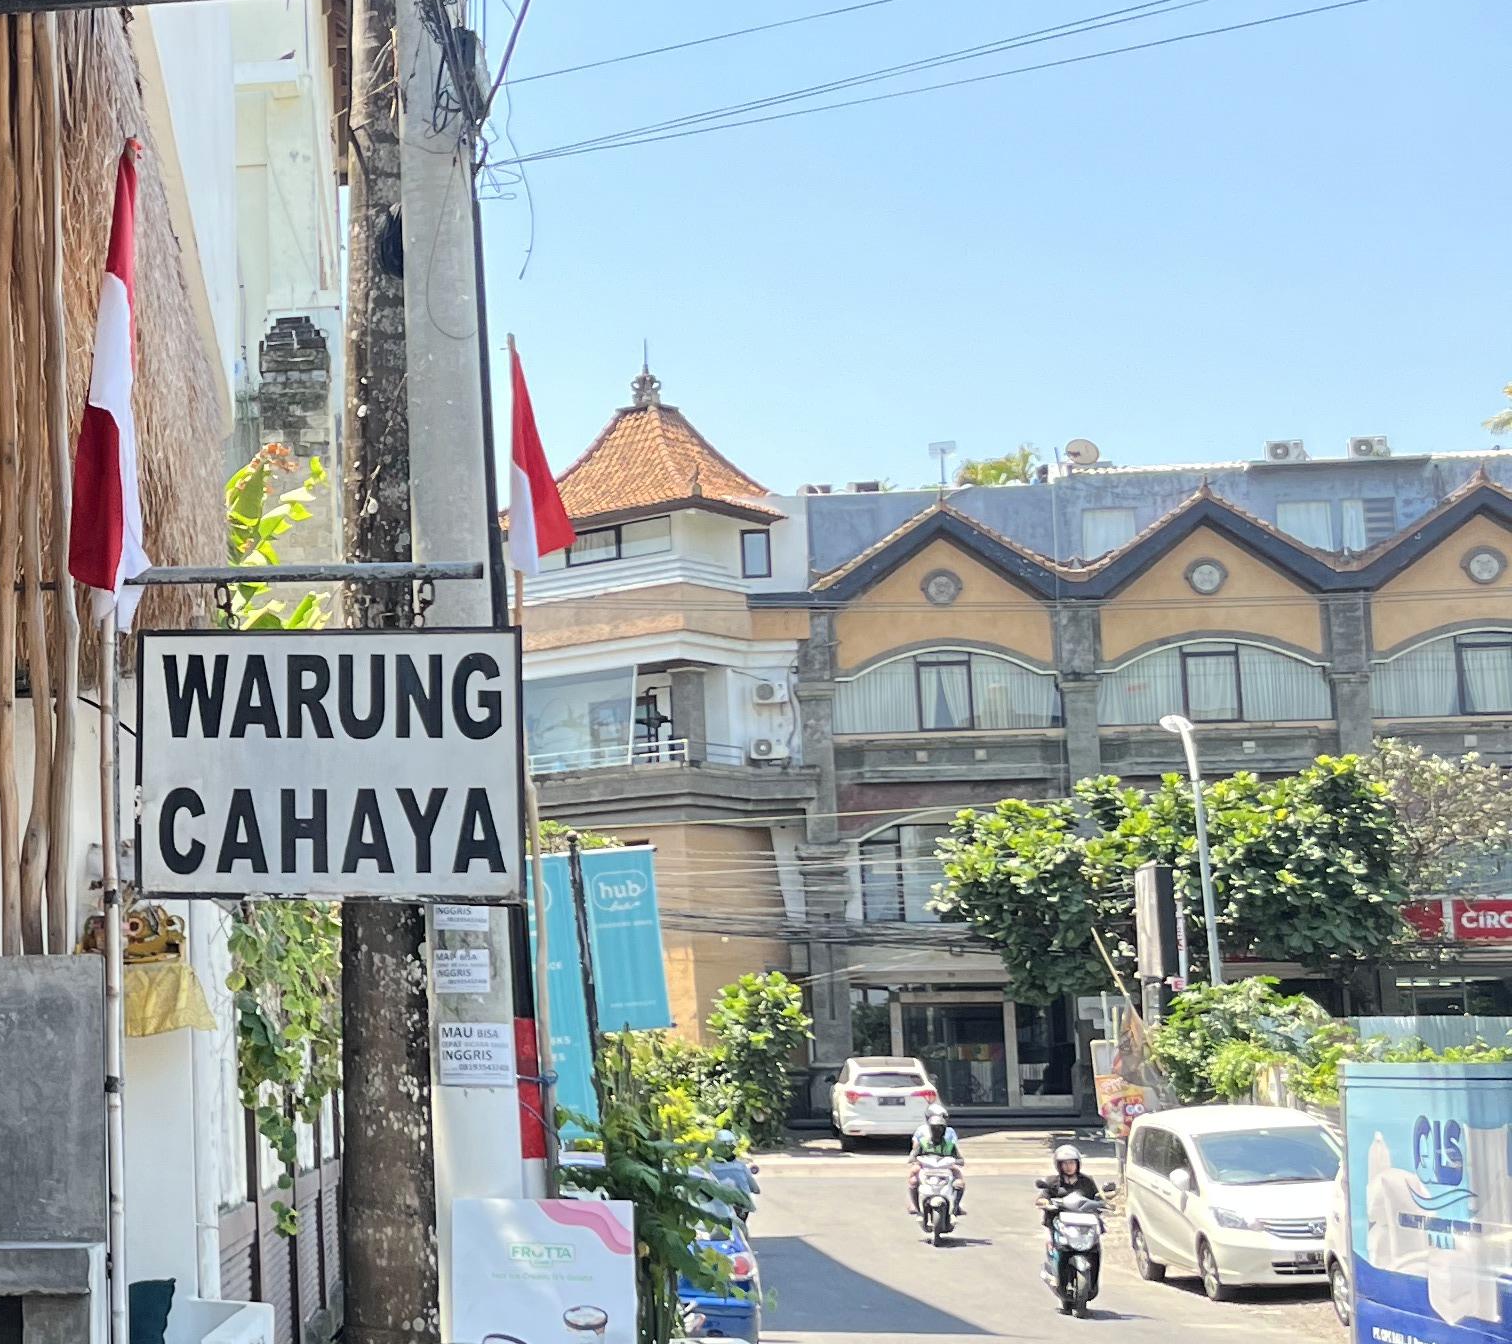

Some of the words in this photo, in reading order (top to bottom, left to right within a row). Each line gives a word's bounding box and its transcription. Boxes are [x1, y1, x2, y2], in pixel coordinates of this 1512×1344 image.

[162, 652, 503, 740] WARUNG
[159, 787, 507, 875] CAHAYA
[598, 879, 641, 899] hub
[441, 1026, 473, 1038] MAU
[477, 1029, 499, 1038] BISA
[441, 1049, 493, 1061] INGGRIS
